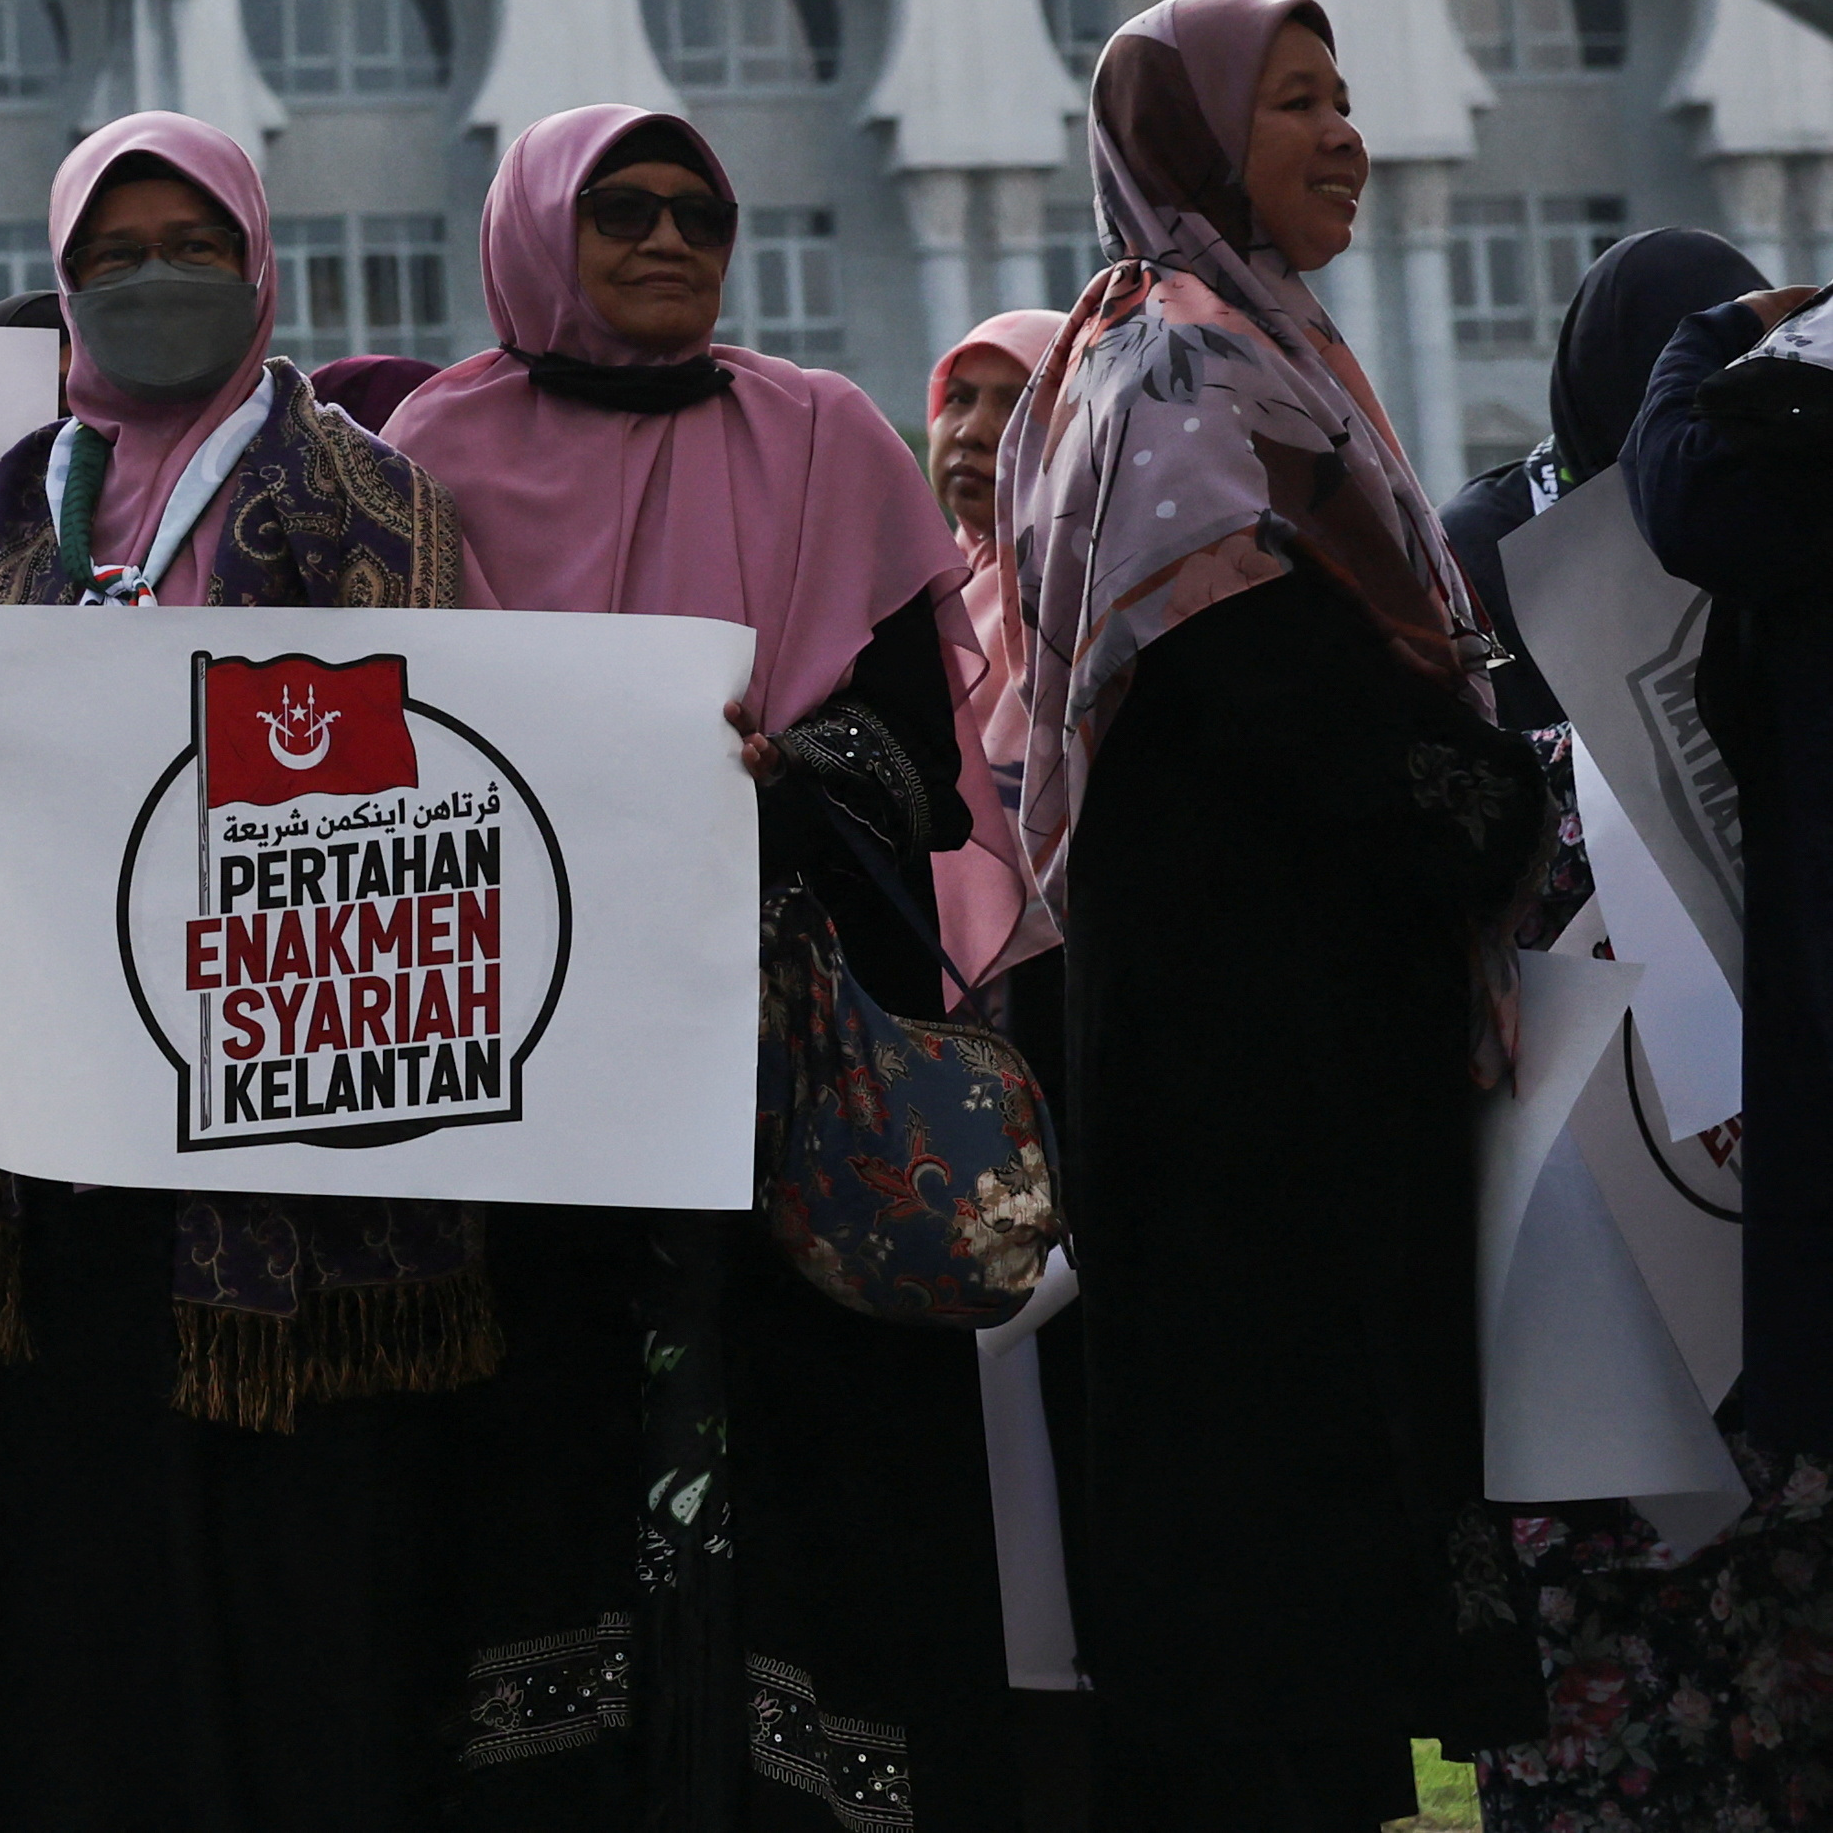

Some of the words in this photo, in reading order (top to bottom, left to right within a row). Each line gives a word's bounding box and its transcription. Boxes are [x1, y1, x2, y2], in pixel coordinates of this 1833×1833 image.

[221, 827, 501, 914] PERTAHAN
[186, 888, 501, 991] ENAKMEN
[222, 963, 501, 1060] SYARIAH
[224, 1038, 501, 1124] KELANTAN
